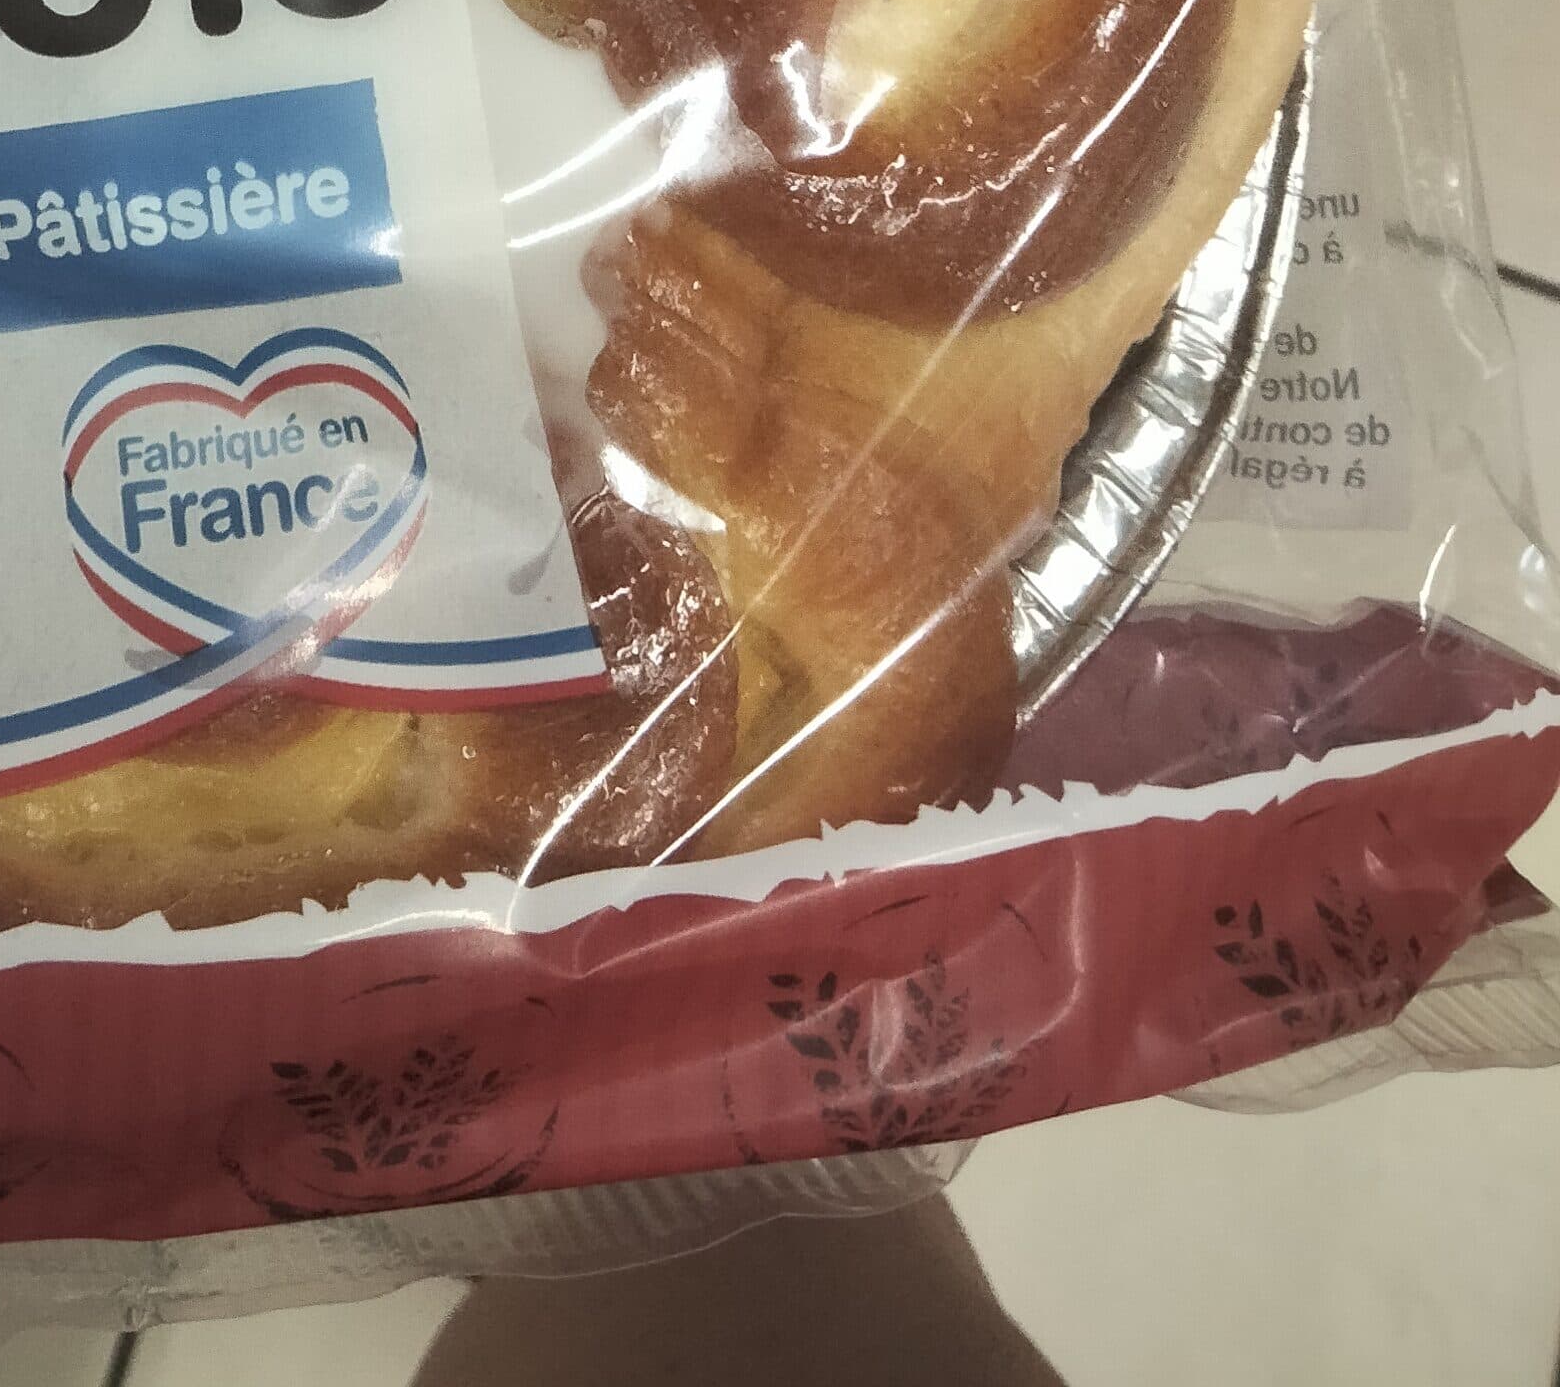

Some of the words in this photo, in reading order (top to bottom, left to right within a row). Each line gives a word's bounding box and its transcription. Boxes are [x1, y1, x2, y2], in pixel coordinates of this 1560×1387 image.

[115, 411, 307, 477] Fabriqué
[318, 409, 370, 449] en
[120, 463, 383, 554] France
